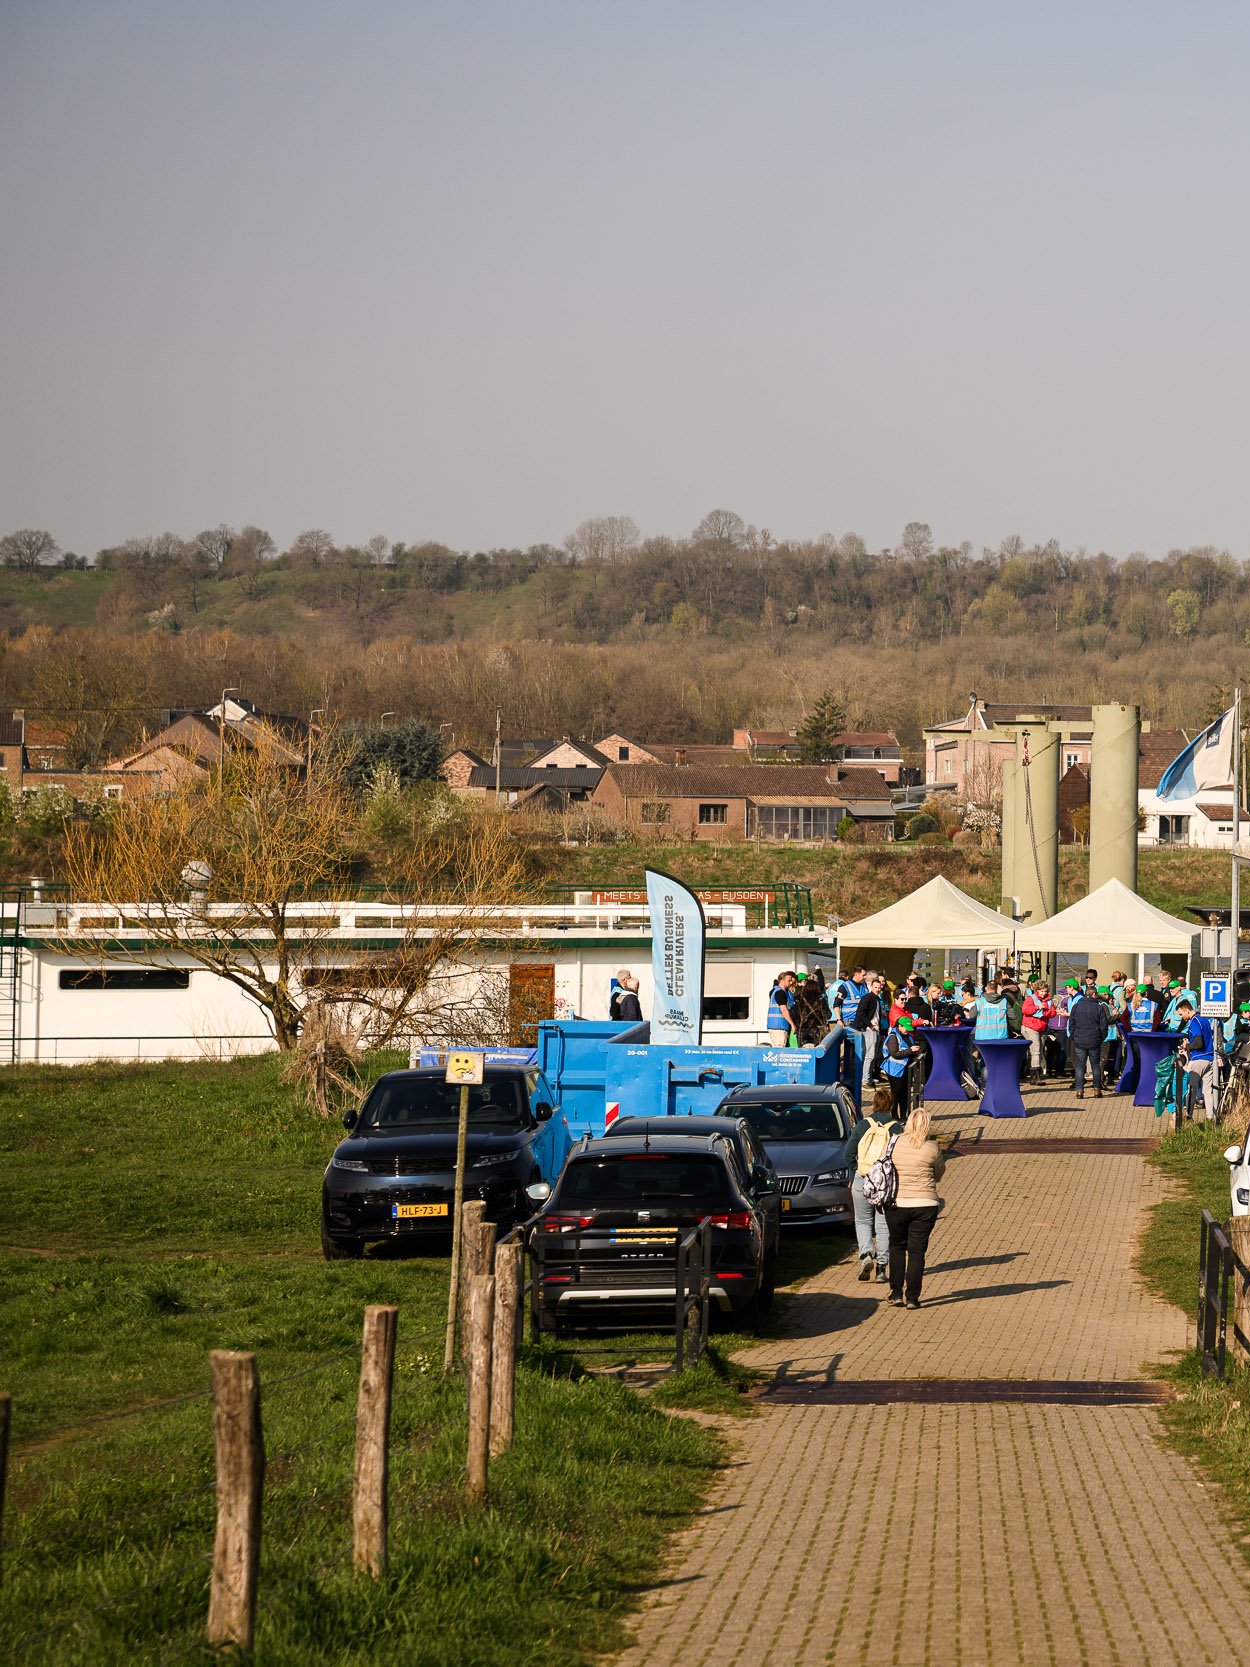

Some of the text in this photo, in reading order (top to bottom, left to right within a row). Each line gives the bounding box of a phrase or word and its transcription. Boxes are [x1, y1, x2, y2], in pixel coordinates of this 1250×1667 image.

[722, 891, 764, 900] EIJSDEN
[1209, 982, 1222, 1000] P
[401, 1205, 442, 1216] HLF-73-J
